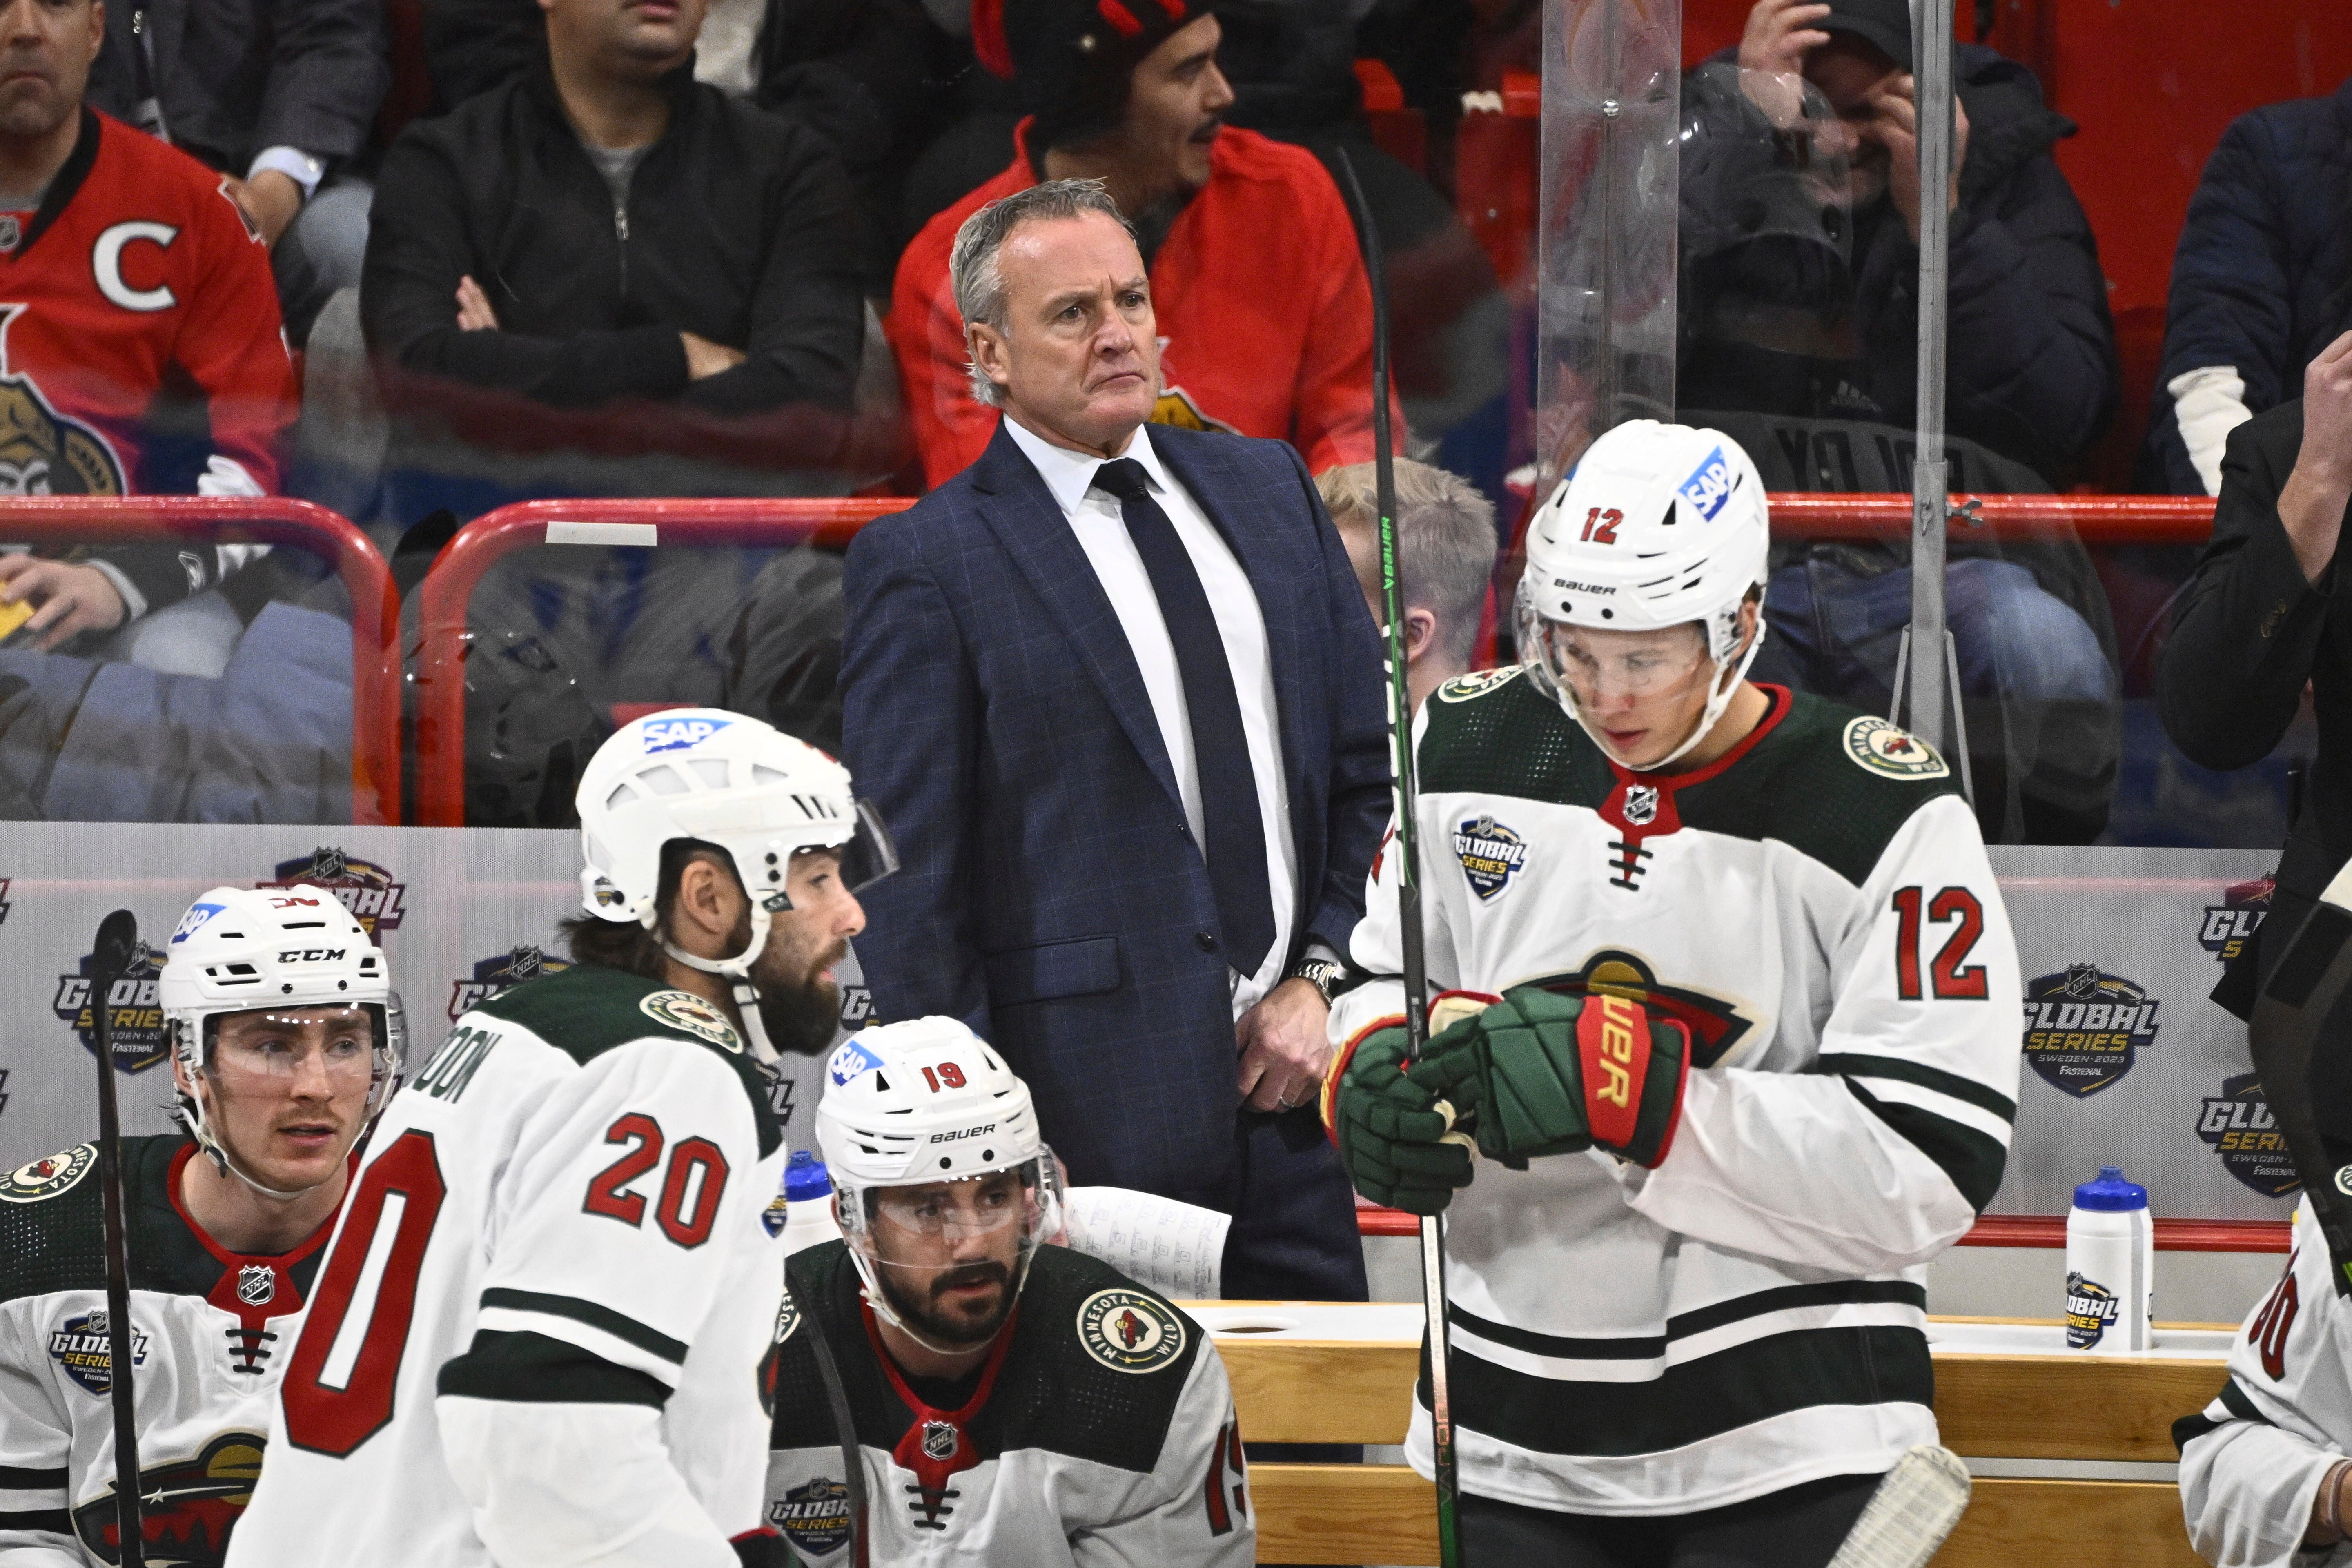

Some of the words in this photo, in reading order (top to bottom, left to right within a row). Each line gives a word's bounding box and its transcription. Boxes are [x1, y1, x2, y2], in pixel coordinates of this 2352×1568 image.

[93, 221, 178, 311] C
[1686, 461, 1728, 515] SAP
[1580, 507, 1624, 544] 12
[644, 722, 713, 751] SAP
[1454, 835, 1524, 865] GLOBAL
[1463, 855, 1508, 874] SERIES
[278, 949, 346, 963] CCM
[1892, 885, 1990, 1001] 12
[2023, 1002, 2154, 1035] GLOBAL
[2026, 1033, 2129, 1051] SERIES
[831, 1046, 867, 1081] SAP
[921, 1062, 967, 1094] 19
[581, 1111, 731, 1251] 20
[246, 1277, 267, 1296] NHL
[1086, 1295, 1130, 1360] MINNESOTA
[2067, 1314, 2100, 1330] RIES
[51, 1334, 144, 1358] GLOBL
[1156, 1324, 1178, 1356] WILD
[929, 1432, 949, 1451] NHL
[786, 1517, 849, 1530] SERIES
